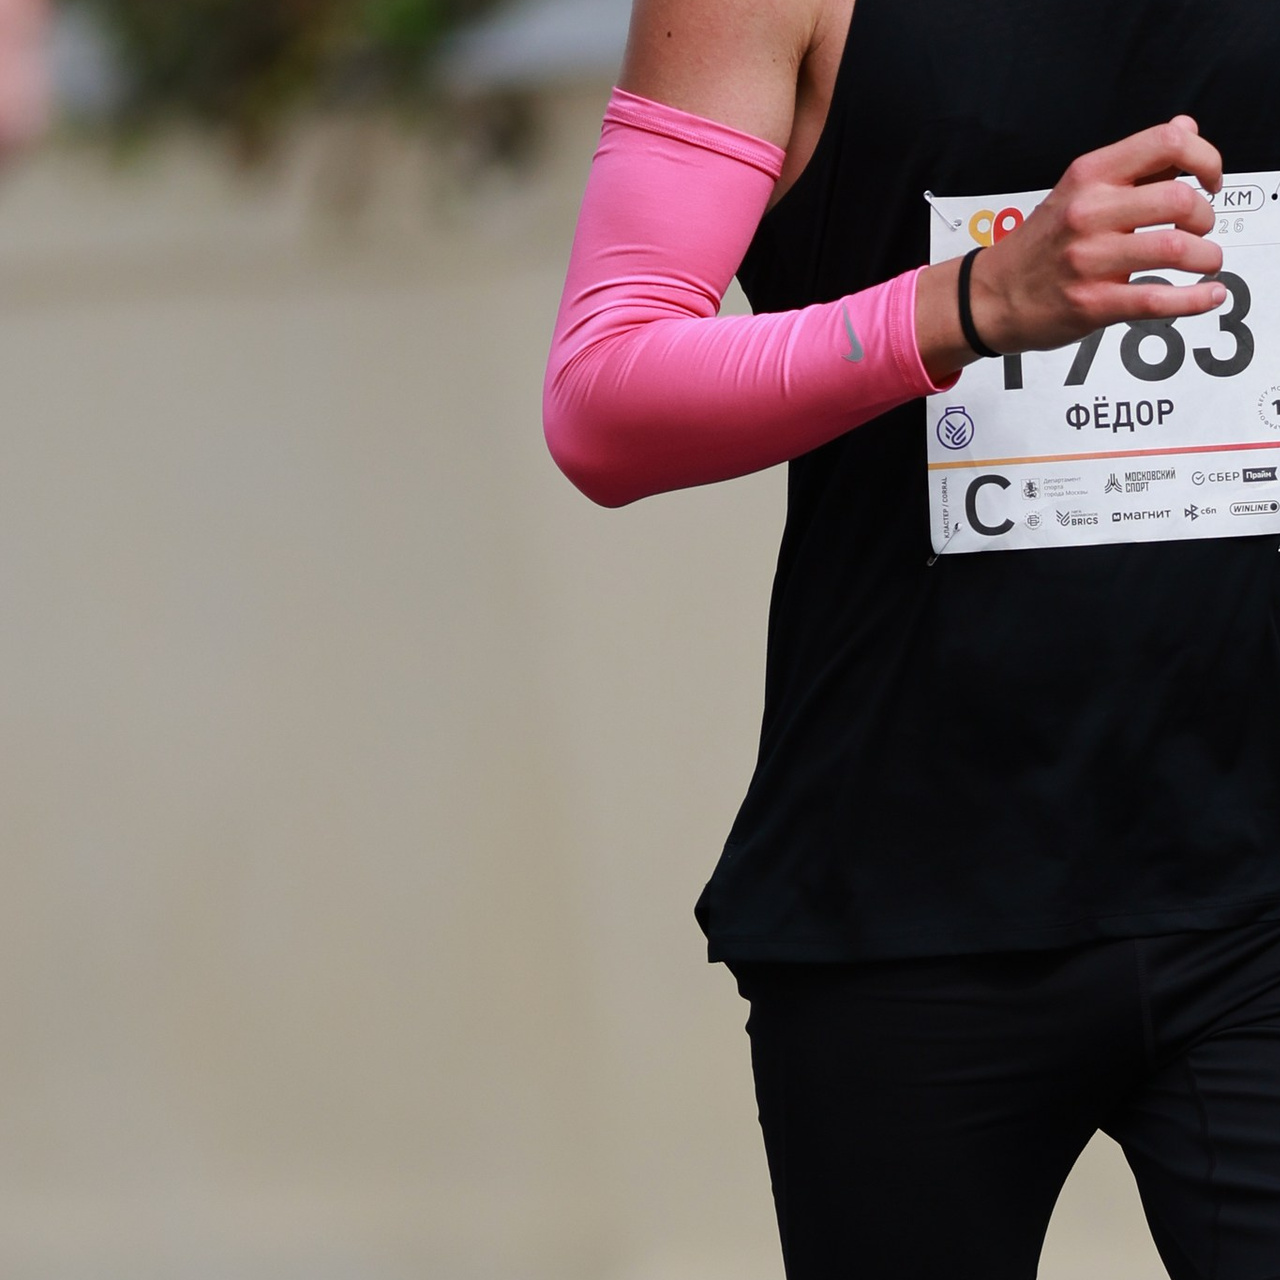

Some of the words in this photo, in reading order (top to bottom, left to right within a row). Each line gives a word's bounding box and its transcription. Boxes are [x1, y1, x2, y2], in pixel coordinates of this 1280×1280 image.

[1065, 396, 1174, 433] ФЁДОР
[1125, 467, 1176, 482] МОСКОВСКИЙ
[1208, 471, 1240, 482] СБЕР
[1245, 470, 1272, 480] Прайм
[941, 477, 949, 503] CORRAL
[1125, 482, 1150, 493] СПОРТ
[1200, 507, 1217, 515] сбп
[1233, 503, 1269, 513] WINLINE
[942, 508, 950, 538] КЛАСТЕР
[1071, 516, 1098, 526] BRICS
